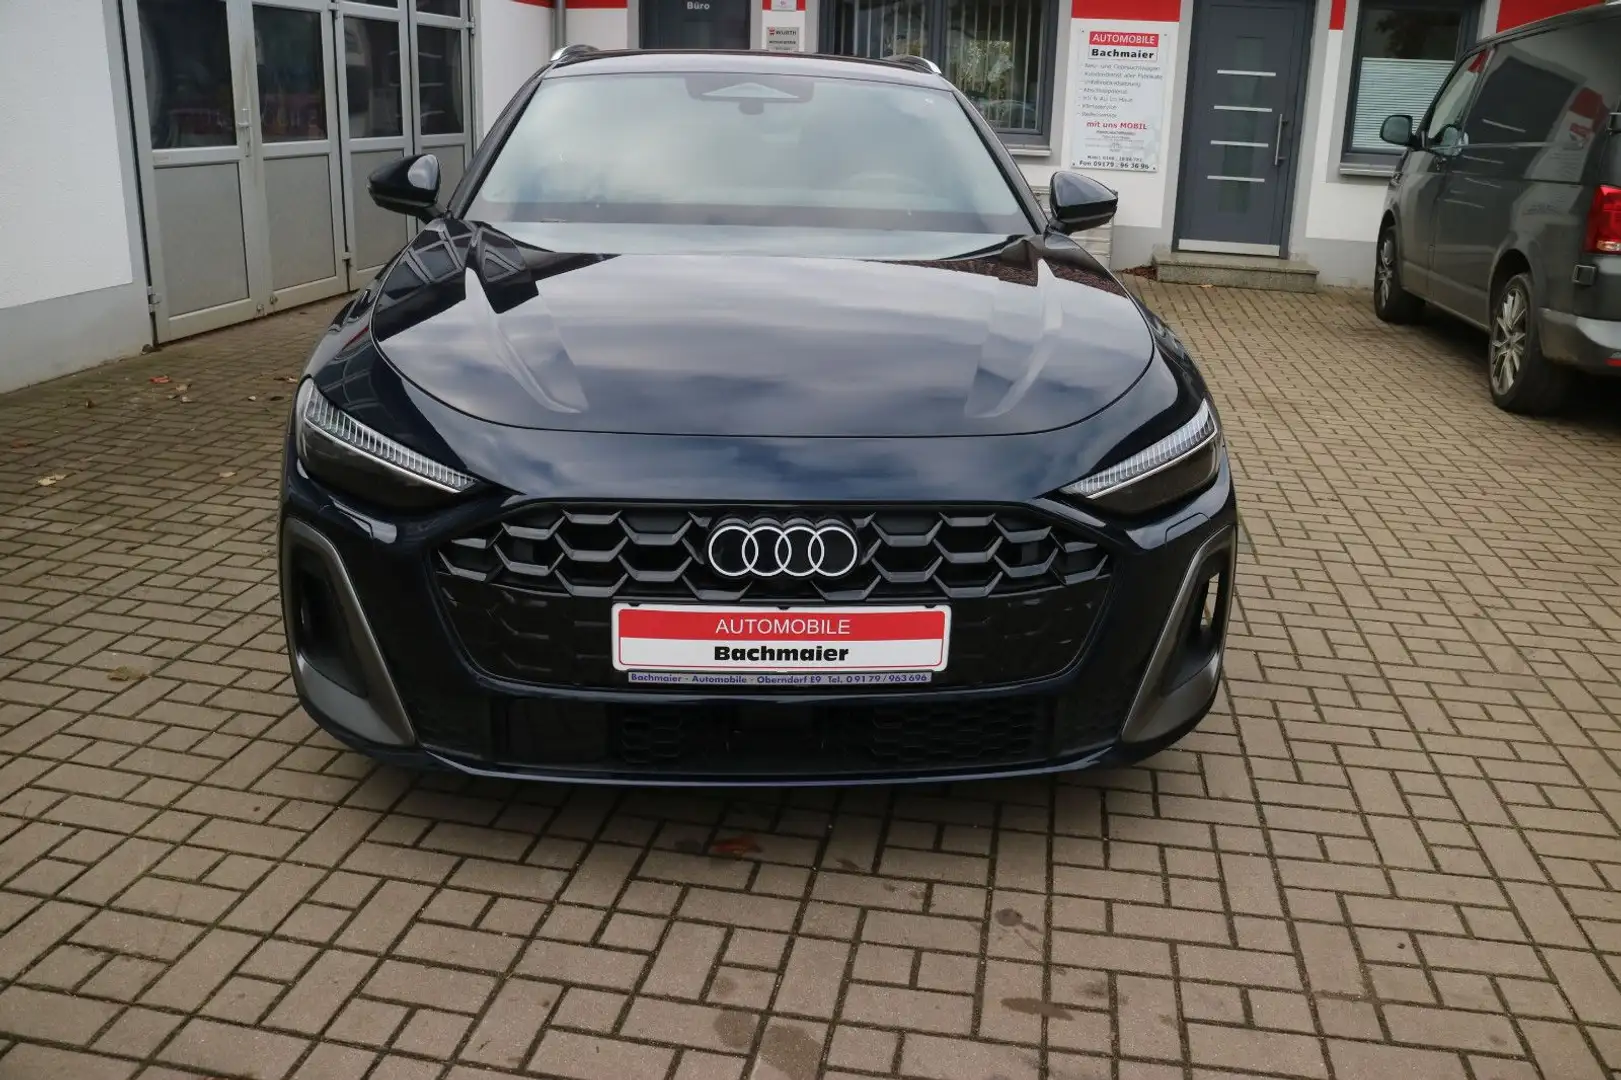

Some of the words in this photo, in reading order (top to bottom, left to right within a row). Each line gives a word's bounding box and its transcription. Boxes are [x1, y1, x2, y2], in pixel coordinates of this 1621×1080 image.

[686, 1, 710, 10] Büro
[1091, 33, 1156, 45] AUTOMOBILE
[1091, 48, 1155, 59] Bachmaier
[1119, 122, 1148, 130] MOBIL
[715, 618, 851, 635] AUTOMOBILE
[714, 645, 849, 662] Bachmaier
[630, 673, 682, 682] Bachmaier
[691, 674, 747, 684] Automobile
[757, 675, 807, 684] Oberndorf
[827, 676, 843, 684] Tel.
